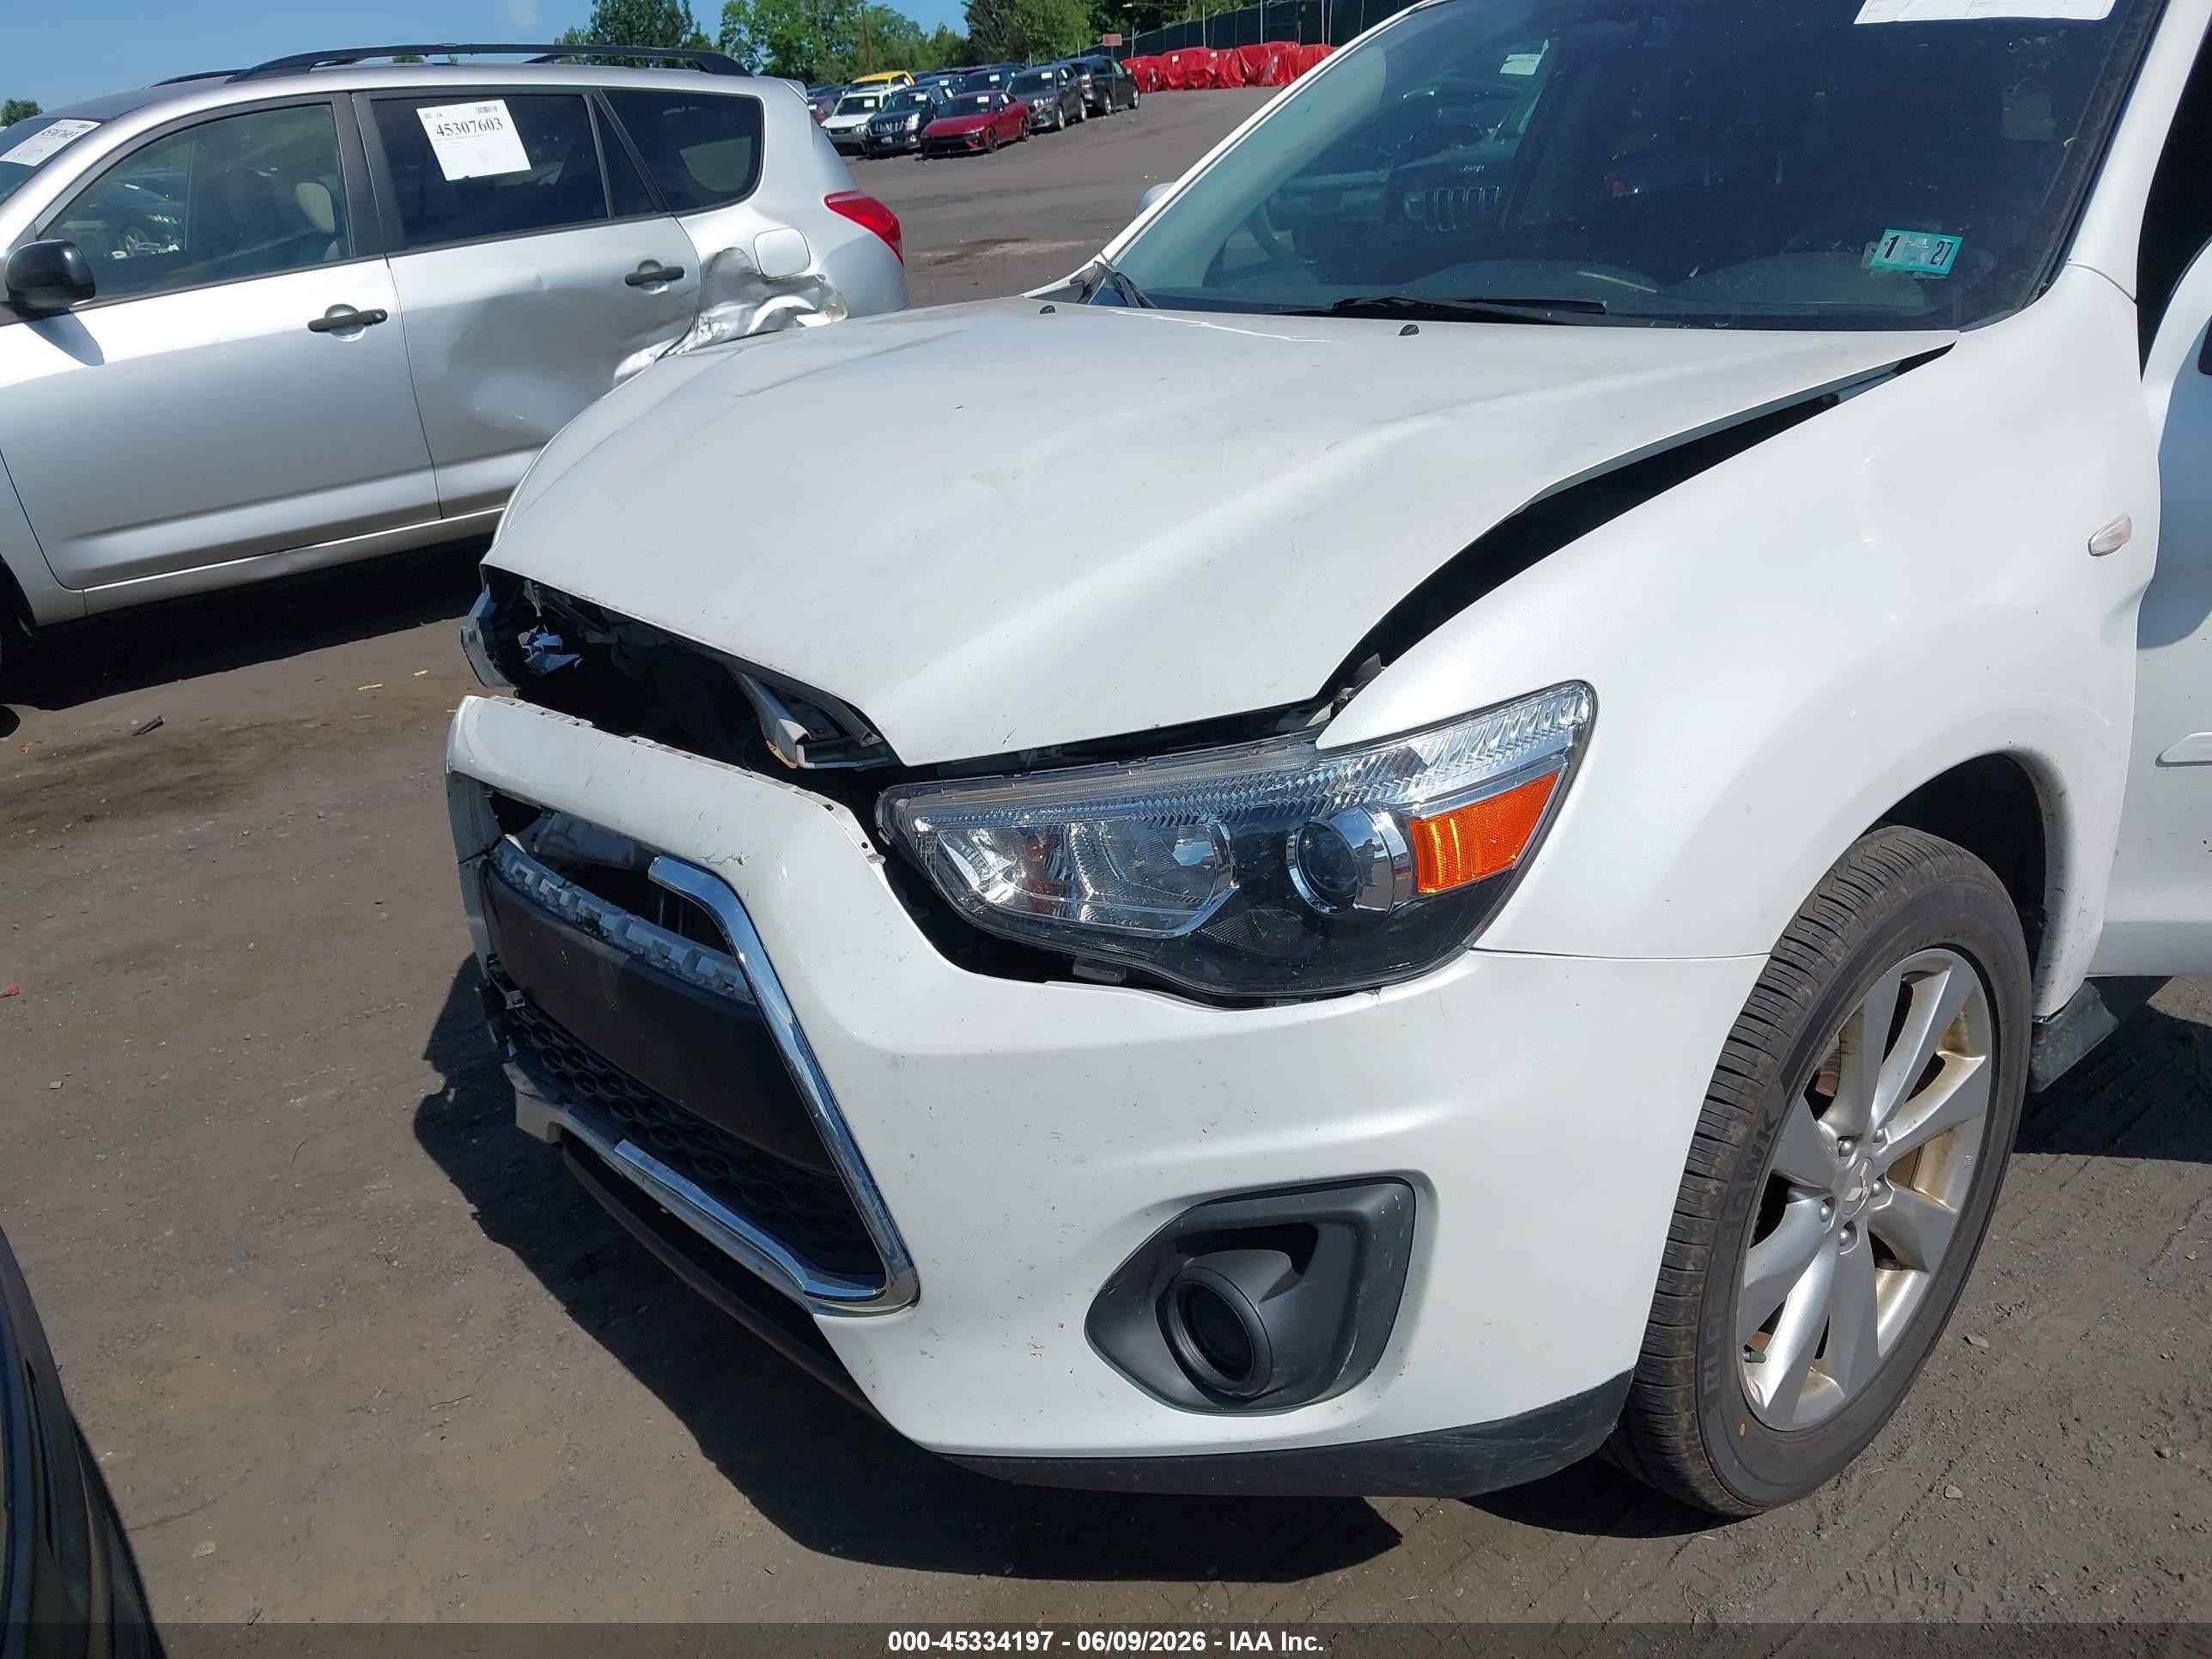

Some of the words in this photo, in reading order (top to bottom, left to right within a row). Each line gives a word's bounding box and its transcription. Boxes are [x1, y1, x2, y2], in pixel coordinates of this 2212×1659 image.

[436, 118, 503, 137] 45307603
[1884, 234, 1900, 258] 1
[1929, 240, 1954, 266] 27
